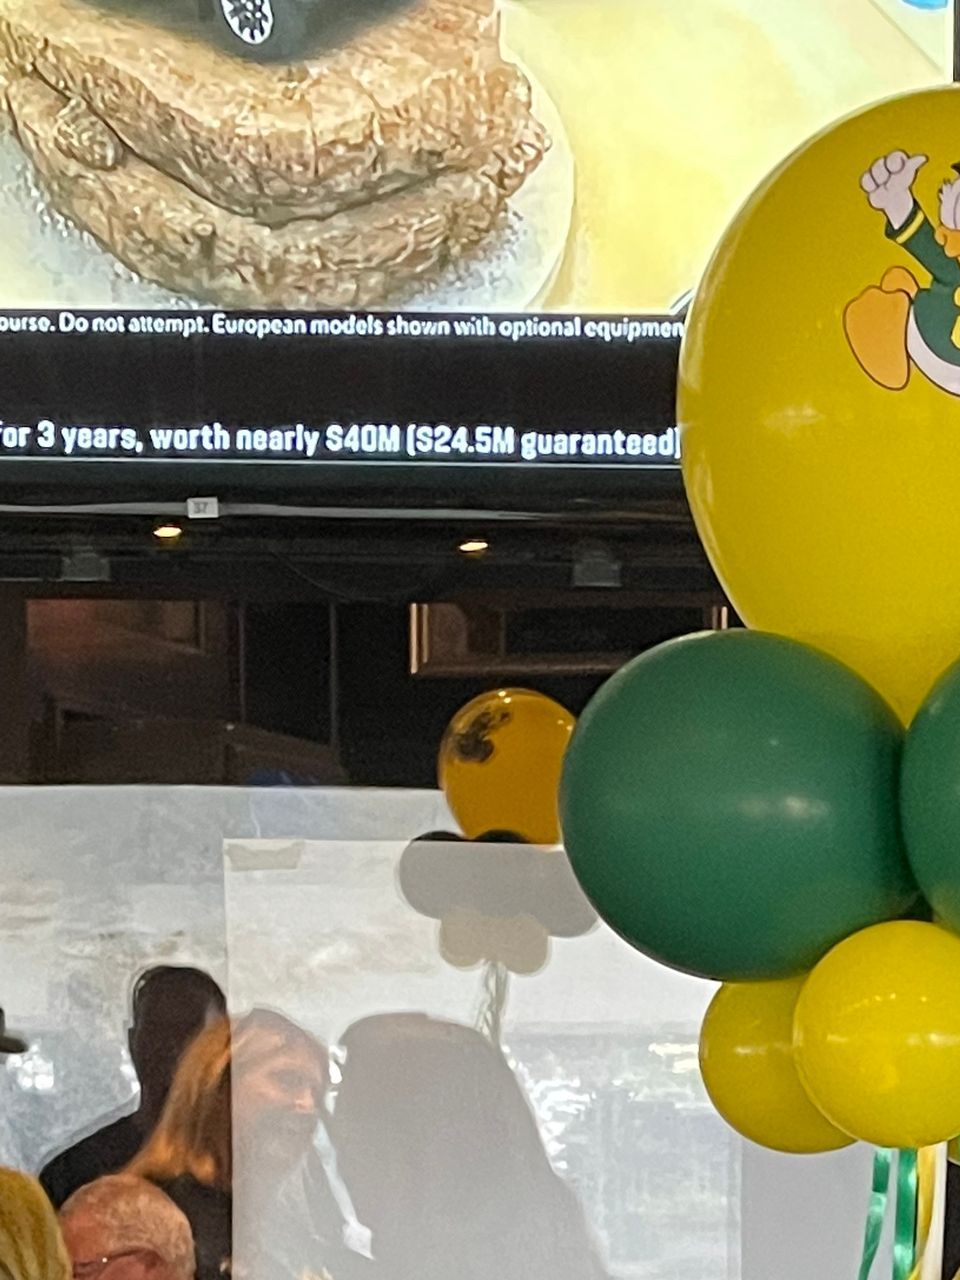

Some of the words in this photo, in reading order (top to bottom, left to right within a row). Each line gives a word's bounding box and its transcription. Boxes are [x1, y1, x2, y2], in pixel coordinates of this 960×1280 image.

[58, 311, 89, 333] Do
[92, 315, 125, 333] not
[128, 315, 210, 338] attempt.
[212, 312, 308, 339] European
[310, 314, 383, 336] models
[386, 314, 450, 336] shown
[454, 316, 497, 336] with
[498, 316, 581, 341] optional
[0, 420, 31, 448] or
[37, 419, 55, 448] 3
[61, 426, 144, 454] years,
[150, 422, 230, 450] worth
[236, 423, 320, 457] nearly
[520, 426, 682, 460] guaranteed)
